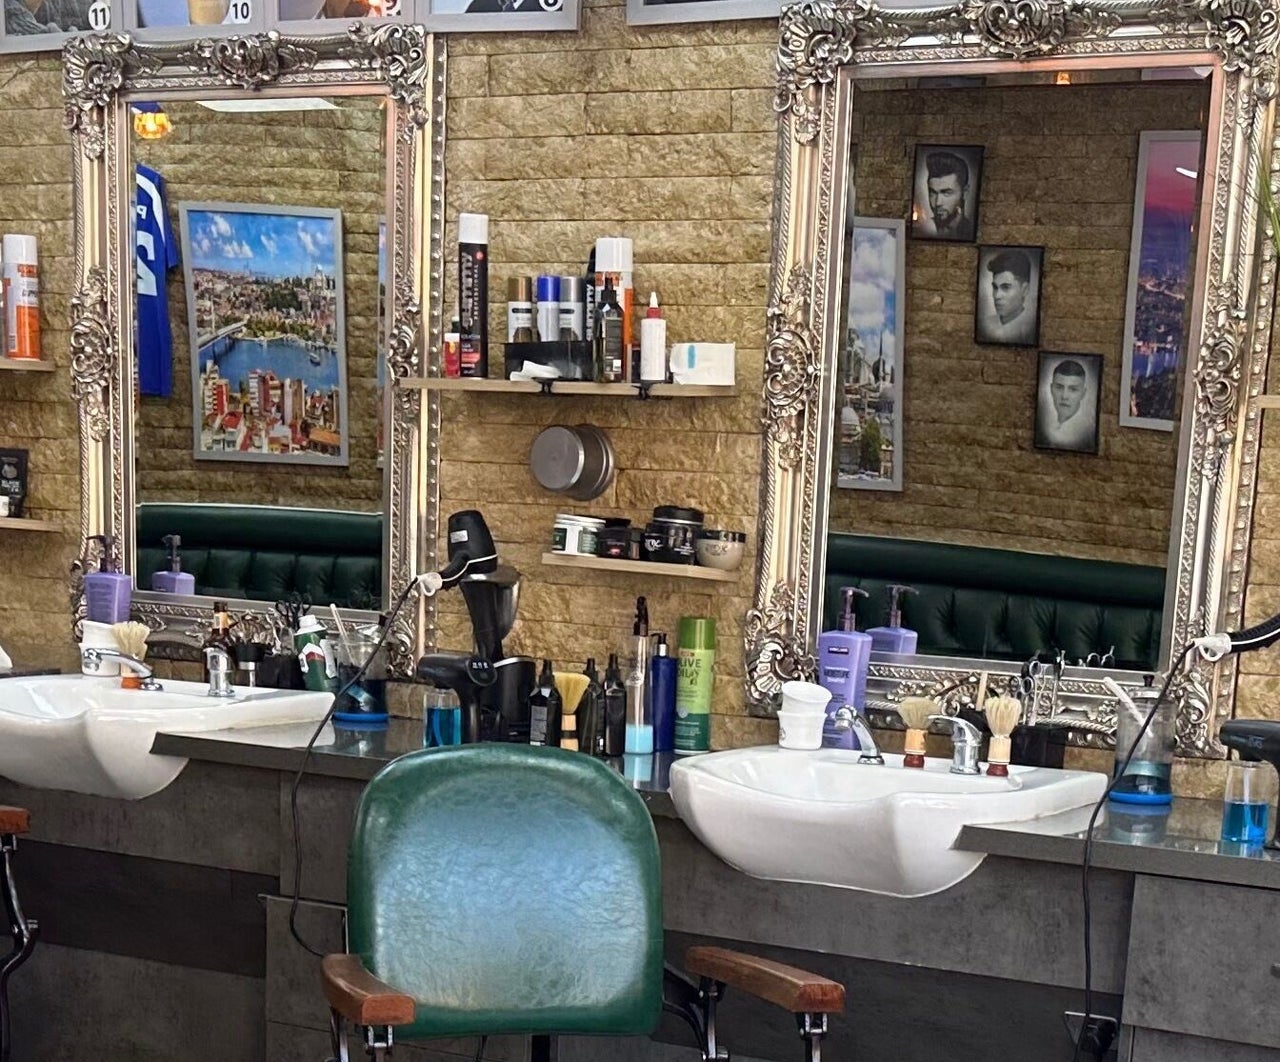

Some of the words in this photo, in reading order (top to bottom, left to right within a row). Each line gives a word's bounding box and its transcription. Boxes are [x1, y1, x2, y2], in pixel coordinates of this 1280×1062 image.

[91, 8, 107, 27] 11
[232, 3, 249, 20] 10
[677, 657, 702, 668] LIVE
